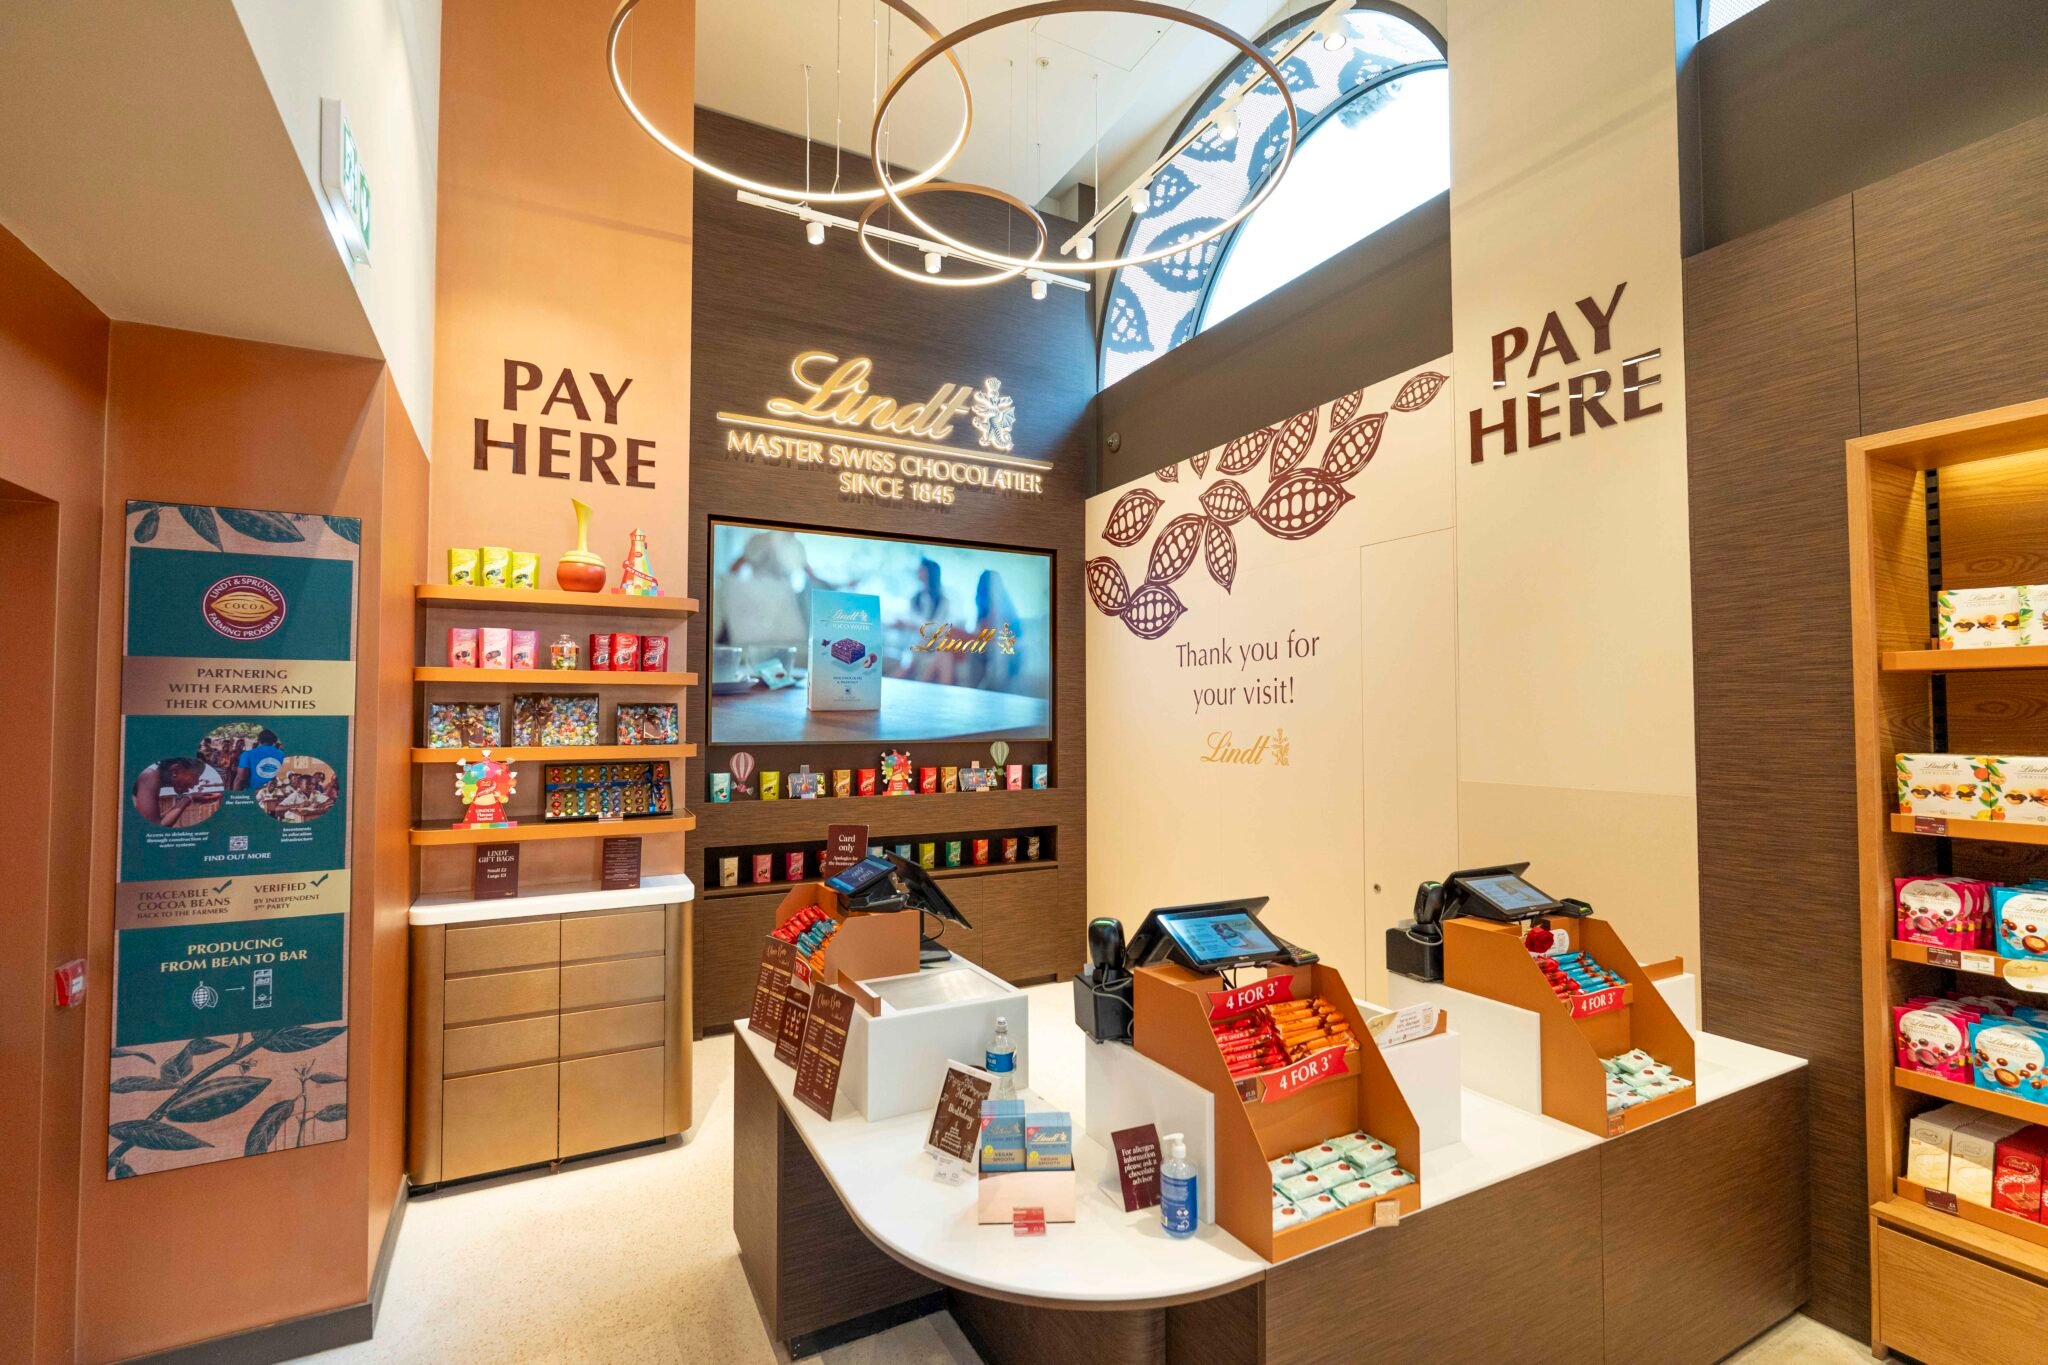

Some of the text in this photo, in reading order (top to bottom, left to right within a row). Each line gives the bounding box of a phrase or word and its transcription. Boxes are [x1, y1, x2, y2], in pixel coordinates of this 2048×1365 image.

[1492, 282, 1627, 389] PAY
[504, 359, 633, 424] PAY
[767, 352, 973, 439] Lindt
[1470, 348, 1662, 464] HERE
[474, 418, 655, 489] HERE
[728, 430, 1043, 494] MASTER SWISS CHOCOLATIER
[839, 472, 954, 506] SINCE 1845
[210, 580, 232, 598] LINDT
[241, 578, 280, 601] SPRÜNGLI
[209, 612, 280, 637] FARMING PROGRAM
[910, 623, 995, 654] Lindt
[1176, 629, 1319, 671] Thank you for
[197, 669, 287, 679] PARTNERING
[169, 684, 312, 694] WITH FARMERS AND
[1193, 676, 1294, 714] your visit!
[165, 700, 316, 709] THEIR COMMUNITIES
[1201, 731, 1271, 764] Lindt
[839, 834, 856, 842] Card
[839, 844, 854, 853] only
[139, 889, 208, 900] TRACEABLE
[254, 883, 306, 893] VERIFIED
[266, 894, 319, 903] INDEPENDENT
[137, 898, 230, 912] COCOA BEANS
[188, 937, 283, 955] PRODUCING
[160, 950, 308, 972] FROM BEAN TO BAR
[1226, 996, 1234, 1009] 4
[1238, 986, 1264, 1007] FOR
[1582, 1000, 1587, 1011] 4
[1589, 995, 1606, 1010] FOR
[1280, 1075, 1287, 1090] 4
[1291, 1061, 1318, 1086] FOR
[957, 1088, 976, 1110] Happy
[948, 1103, 975, 1130] Birthday
[1032, 1132, 1060, 1142] Lindt
[1122, 1144, 1155, 1156] For allergen
[1123, 1151, 1156, 1164] information
[1125, 1163, 1142, 1173] please
[1129, 1167, 1155, 1178] chocolate
[1133, 1175, 1153, 1185] advisor
